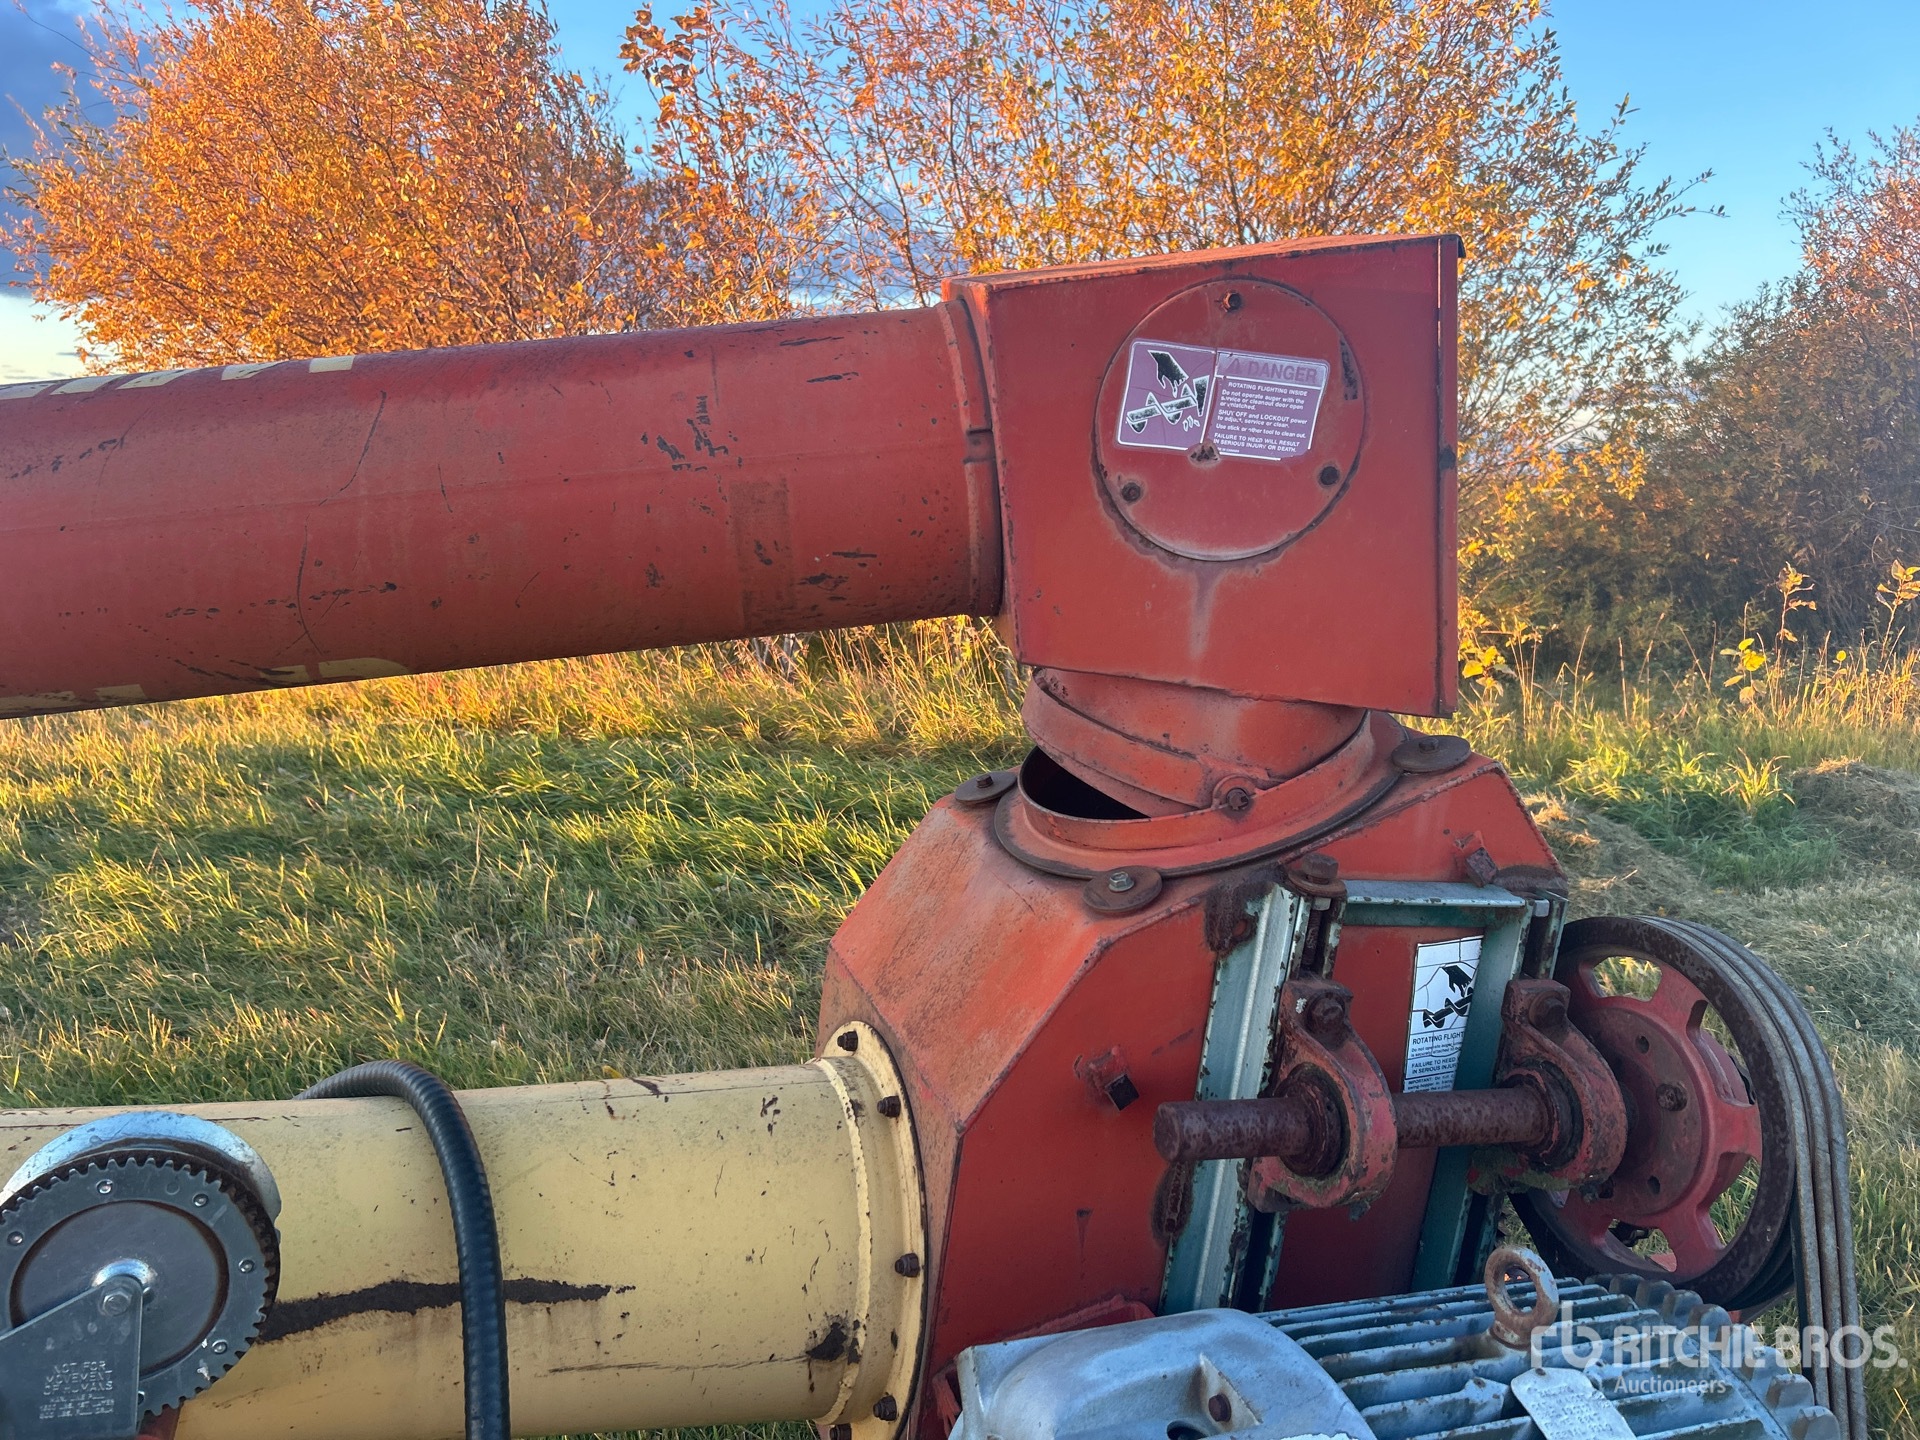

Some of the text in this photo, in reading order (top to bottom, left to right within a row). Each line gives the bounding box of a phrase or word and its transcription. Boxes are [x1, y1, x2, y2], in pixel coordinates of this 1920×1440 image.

[1248, 362, 1317, 383] DANGER
[1413, 1035, 1442, 1044] ROTATING
[55, 1361, 106, 1373] NOT FOR
[46, 1370, 112, 1383] MOVEMENT
[44, 1384, 59, 1395] OF
